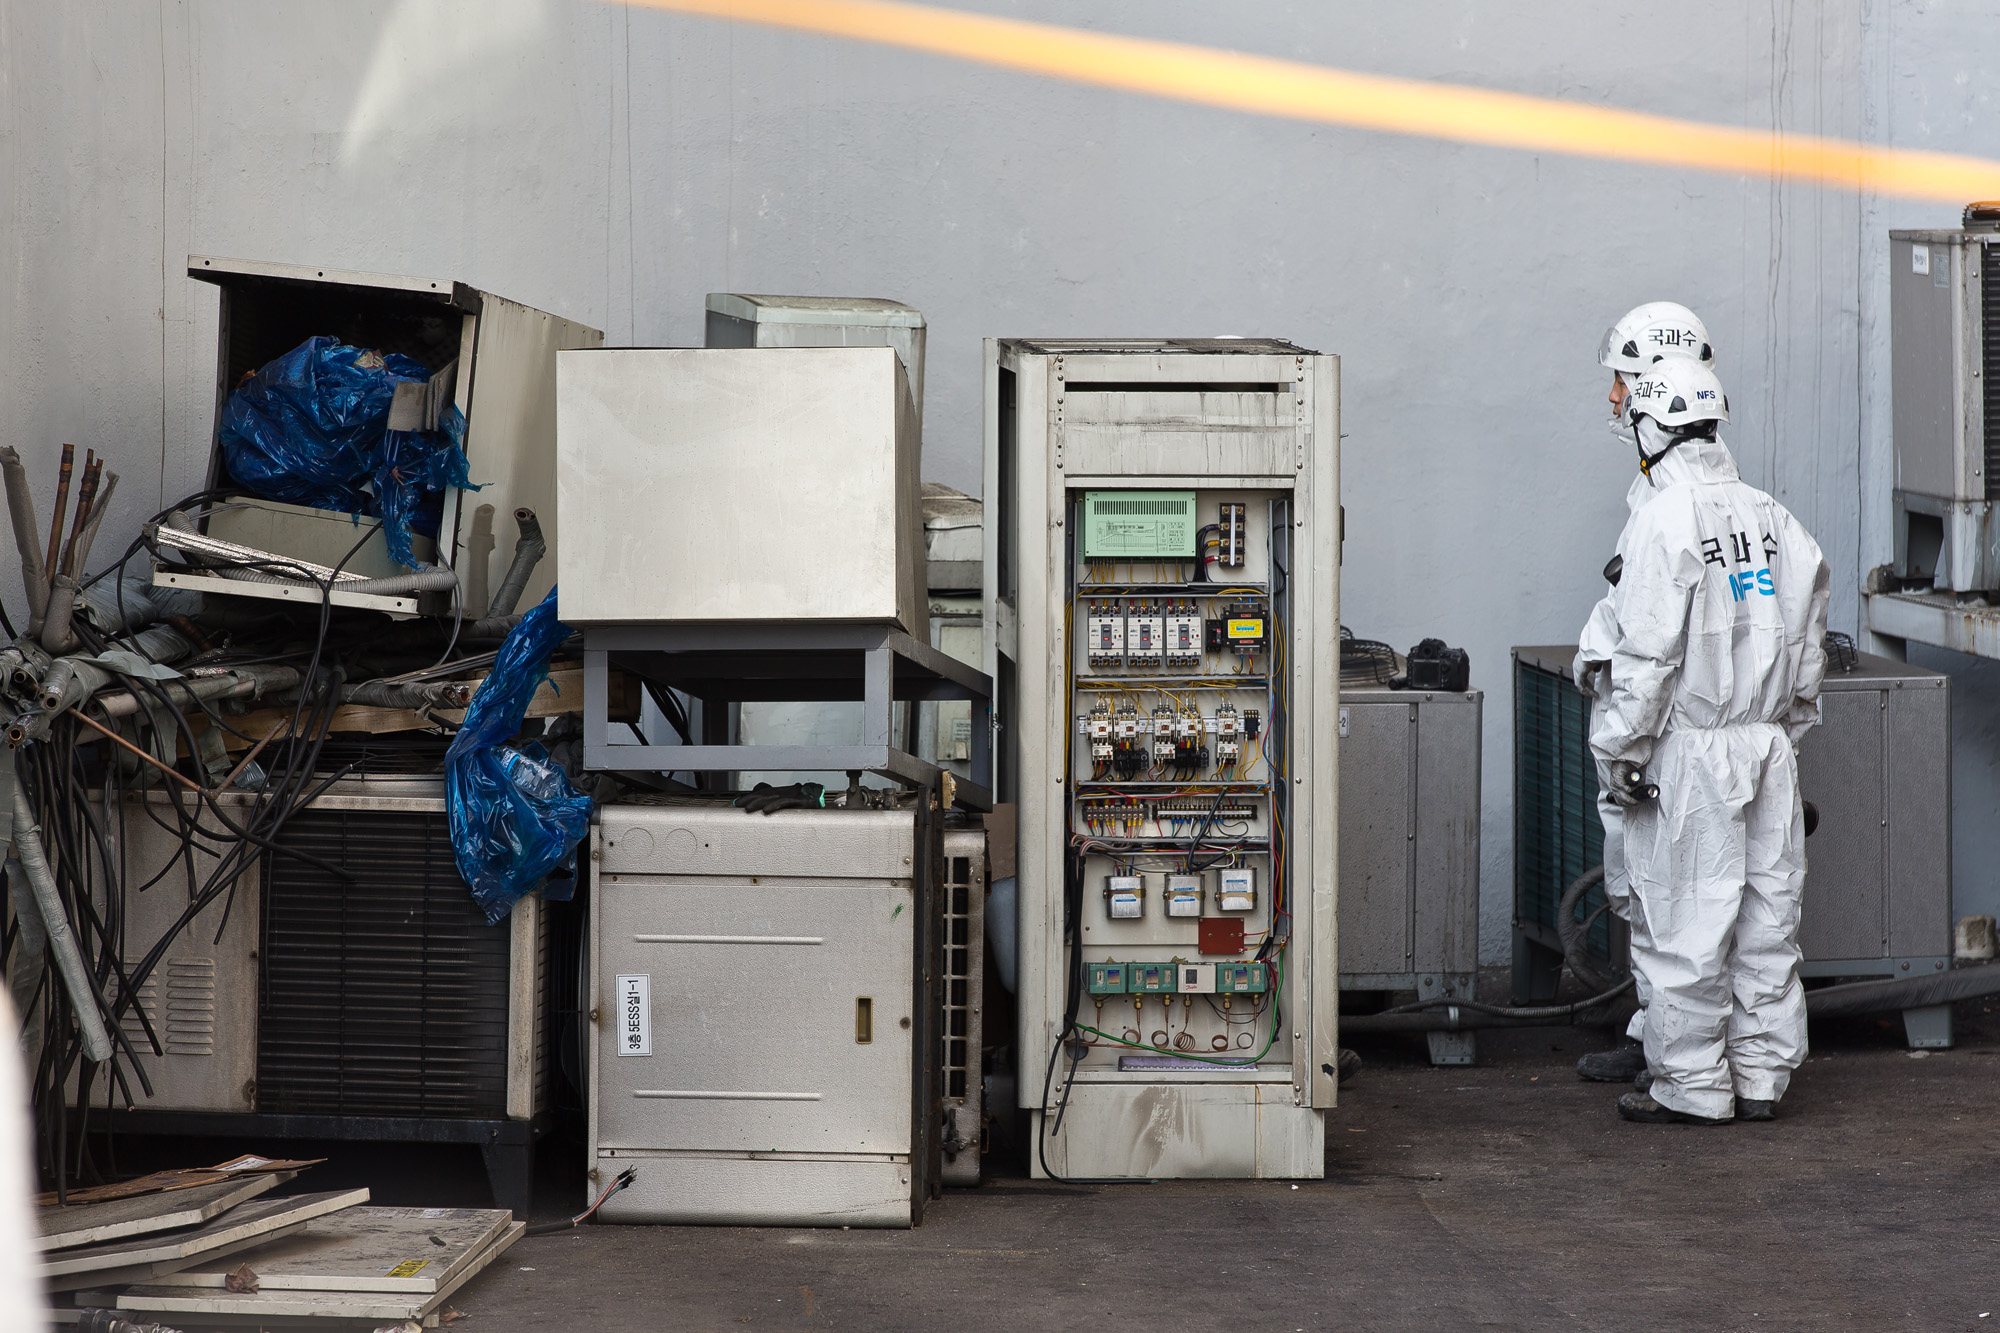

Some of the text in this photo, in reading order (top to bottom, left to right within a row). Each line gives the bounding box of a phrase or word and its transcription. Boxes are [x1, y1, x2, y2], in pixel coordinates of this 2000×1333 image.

[1648, 328, 1697, 347] 국과수
[1634, 381, 1668, 399] 국과수
[1696, 390, 1716, 400] NFS
[1701, 531, 1778, 568] 국과수
[1728, 568, 1776, 602] NFS
